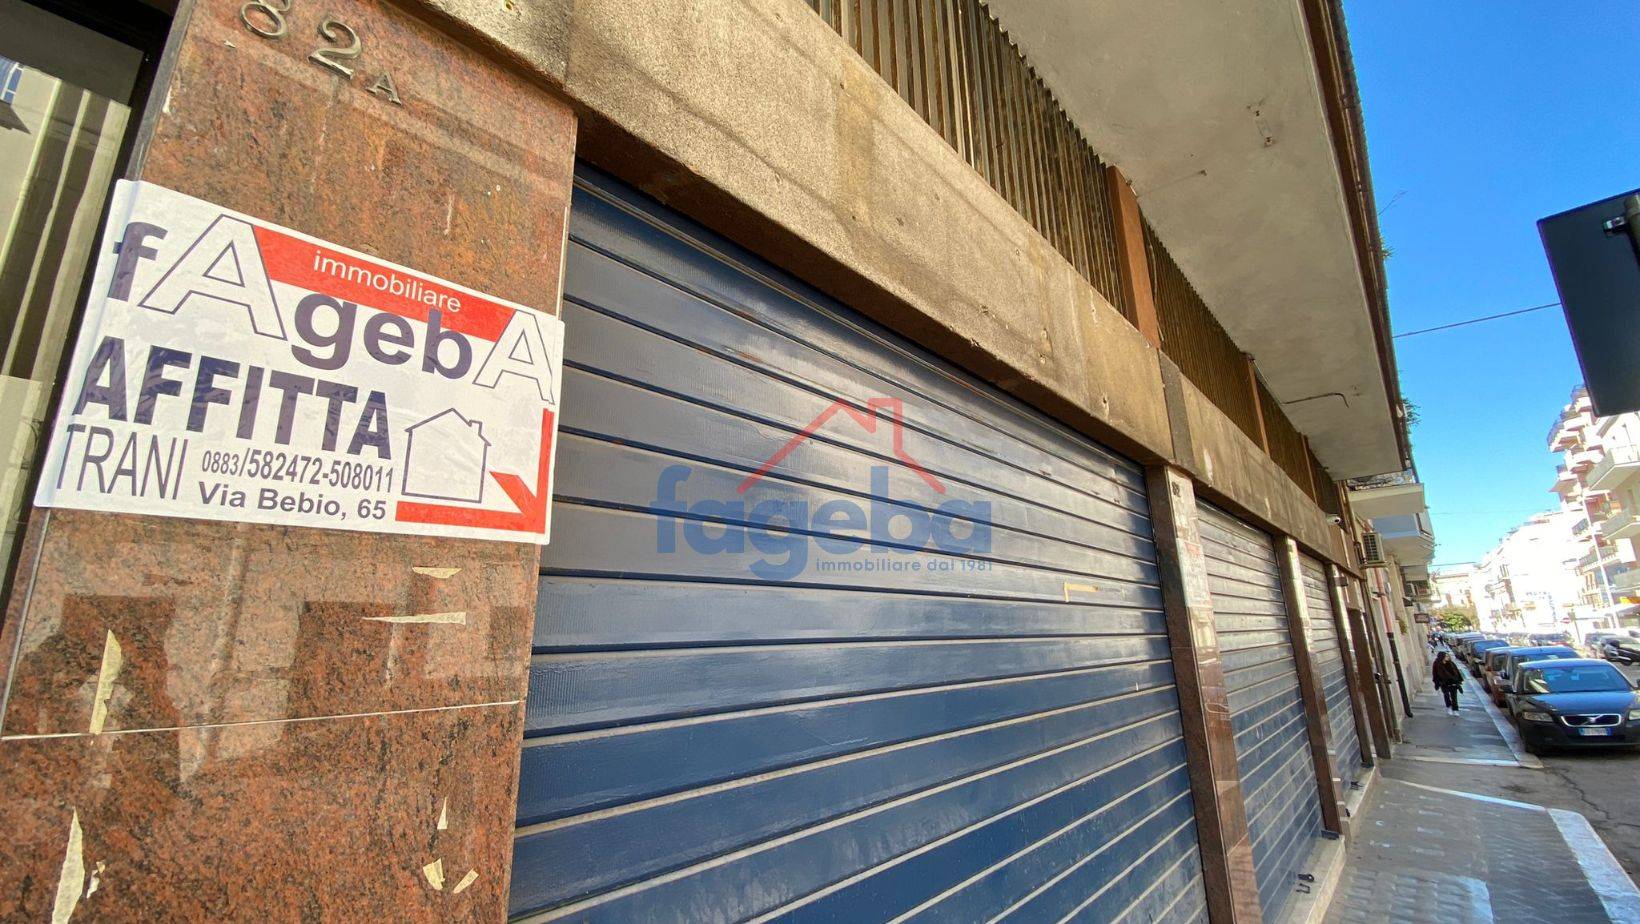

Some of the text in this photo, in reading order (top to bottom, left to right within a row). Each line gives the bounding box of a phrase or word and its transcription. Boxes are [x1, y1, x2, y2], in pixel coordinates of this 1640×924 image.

[313, 250, 462, 314] immobiliare
[73, 335, 392, 461] AFFITTA
[56, 423, 189, 500] TRANI
[201, 447, 394, 493] 0883/582472-508011
[198, 481, 387, 521] Via Bebio, 65
